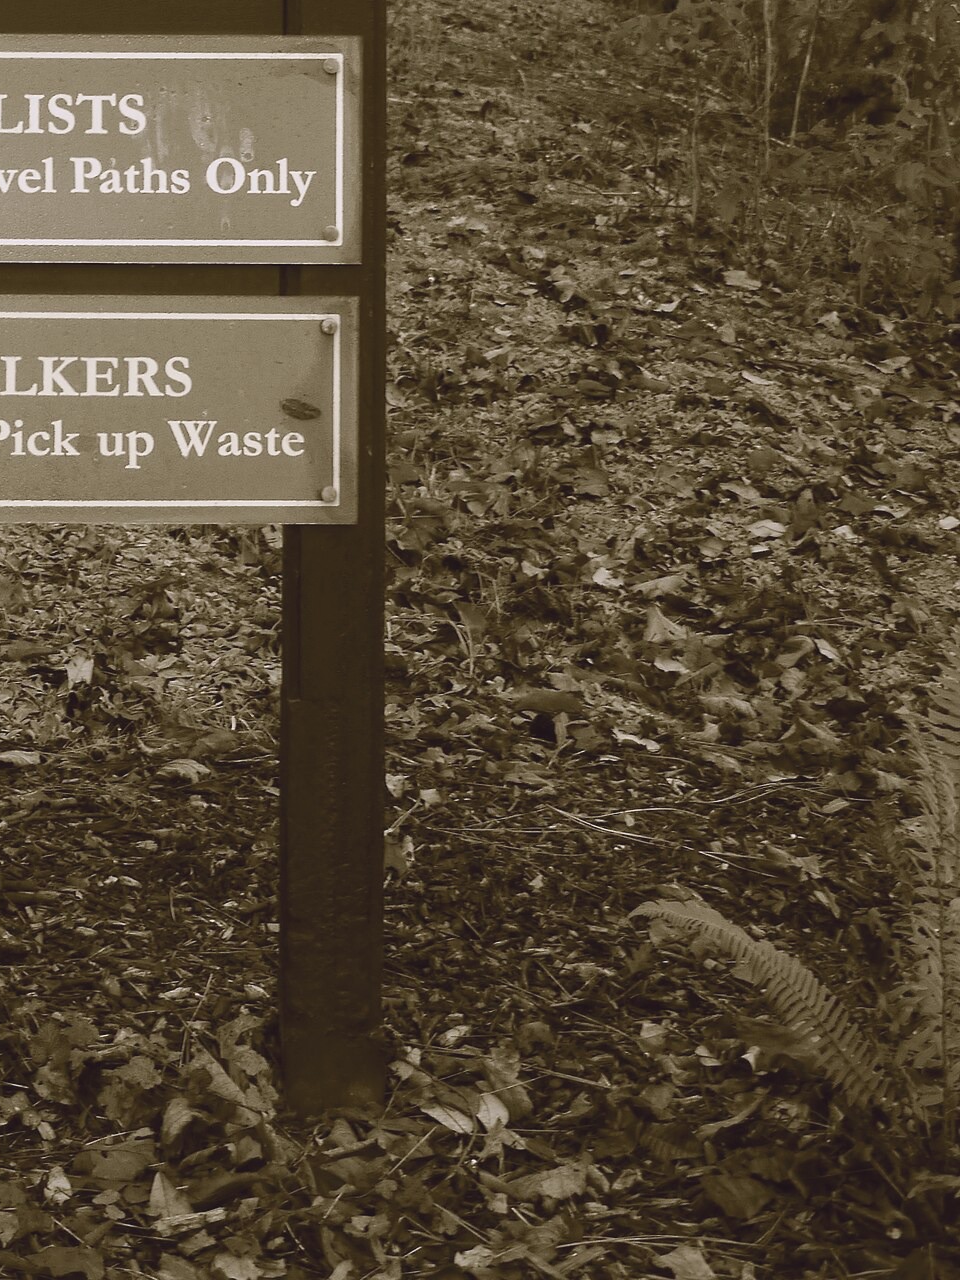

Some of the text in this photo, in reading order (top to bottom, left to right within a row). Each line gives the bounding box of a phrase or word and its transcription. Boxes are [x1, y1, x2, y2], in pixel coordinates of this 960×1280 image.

[70, 159, 191, 195] Paths
[205, 158, 317, 208] Only
[97, 431, 155, 470] up
[167, 420, 306, 459] Waste
